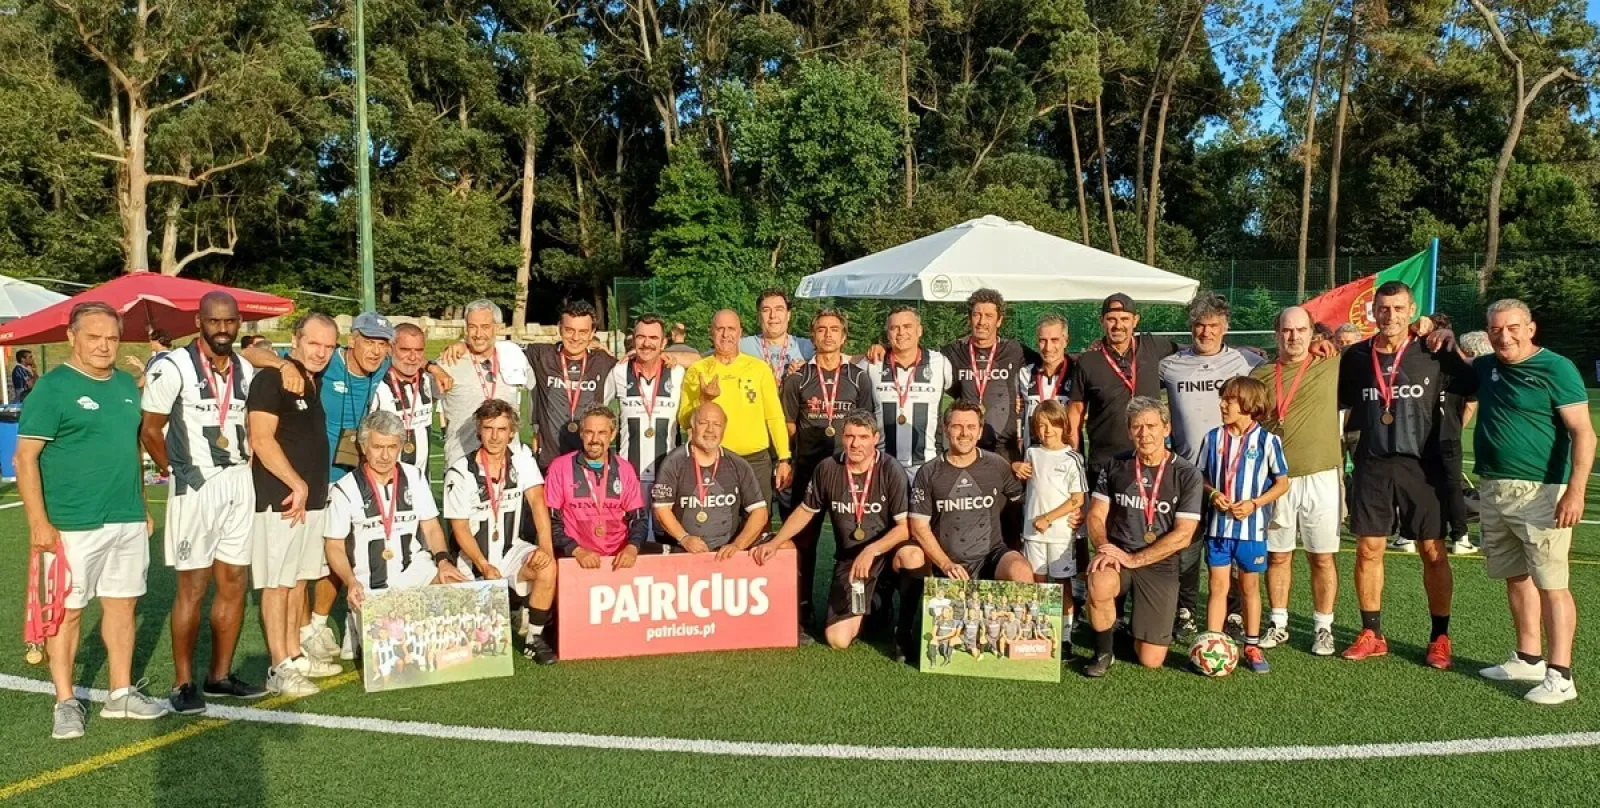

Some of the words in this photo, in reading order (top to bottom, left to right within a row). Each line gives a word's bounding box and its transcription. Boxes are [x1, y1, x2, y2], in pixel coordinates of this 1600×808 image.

[547, 376, 597, 391] FINECO
[1177, 379, 1225, 393] FINIEC
[1362, 384, 1424, 401] FINECO
[622, 400, 676, 408] SINELO
[680, 493, 737, 509] FINIECO
[831, 500, 882, 514] FINICO
[936, 495, 994, 513] FINIECO
[1114, 492, 1171, 514] FINIO
[362, 515, 416, 529] SINELO
[589, 572, 769, 625] PATRICIUS
[646, 622, 716, 641] patricius.pt
